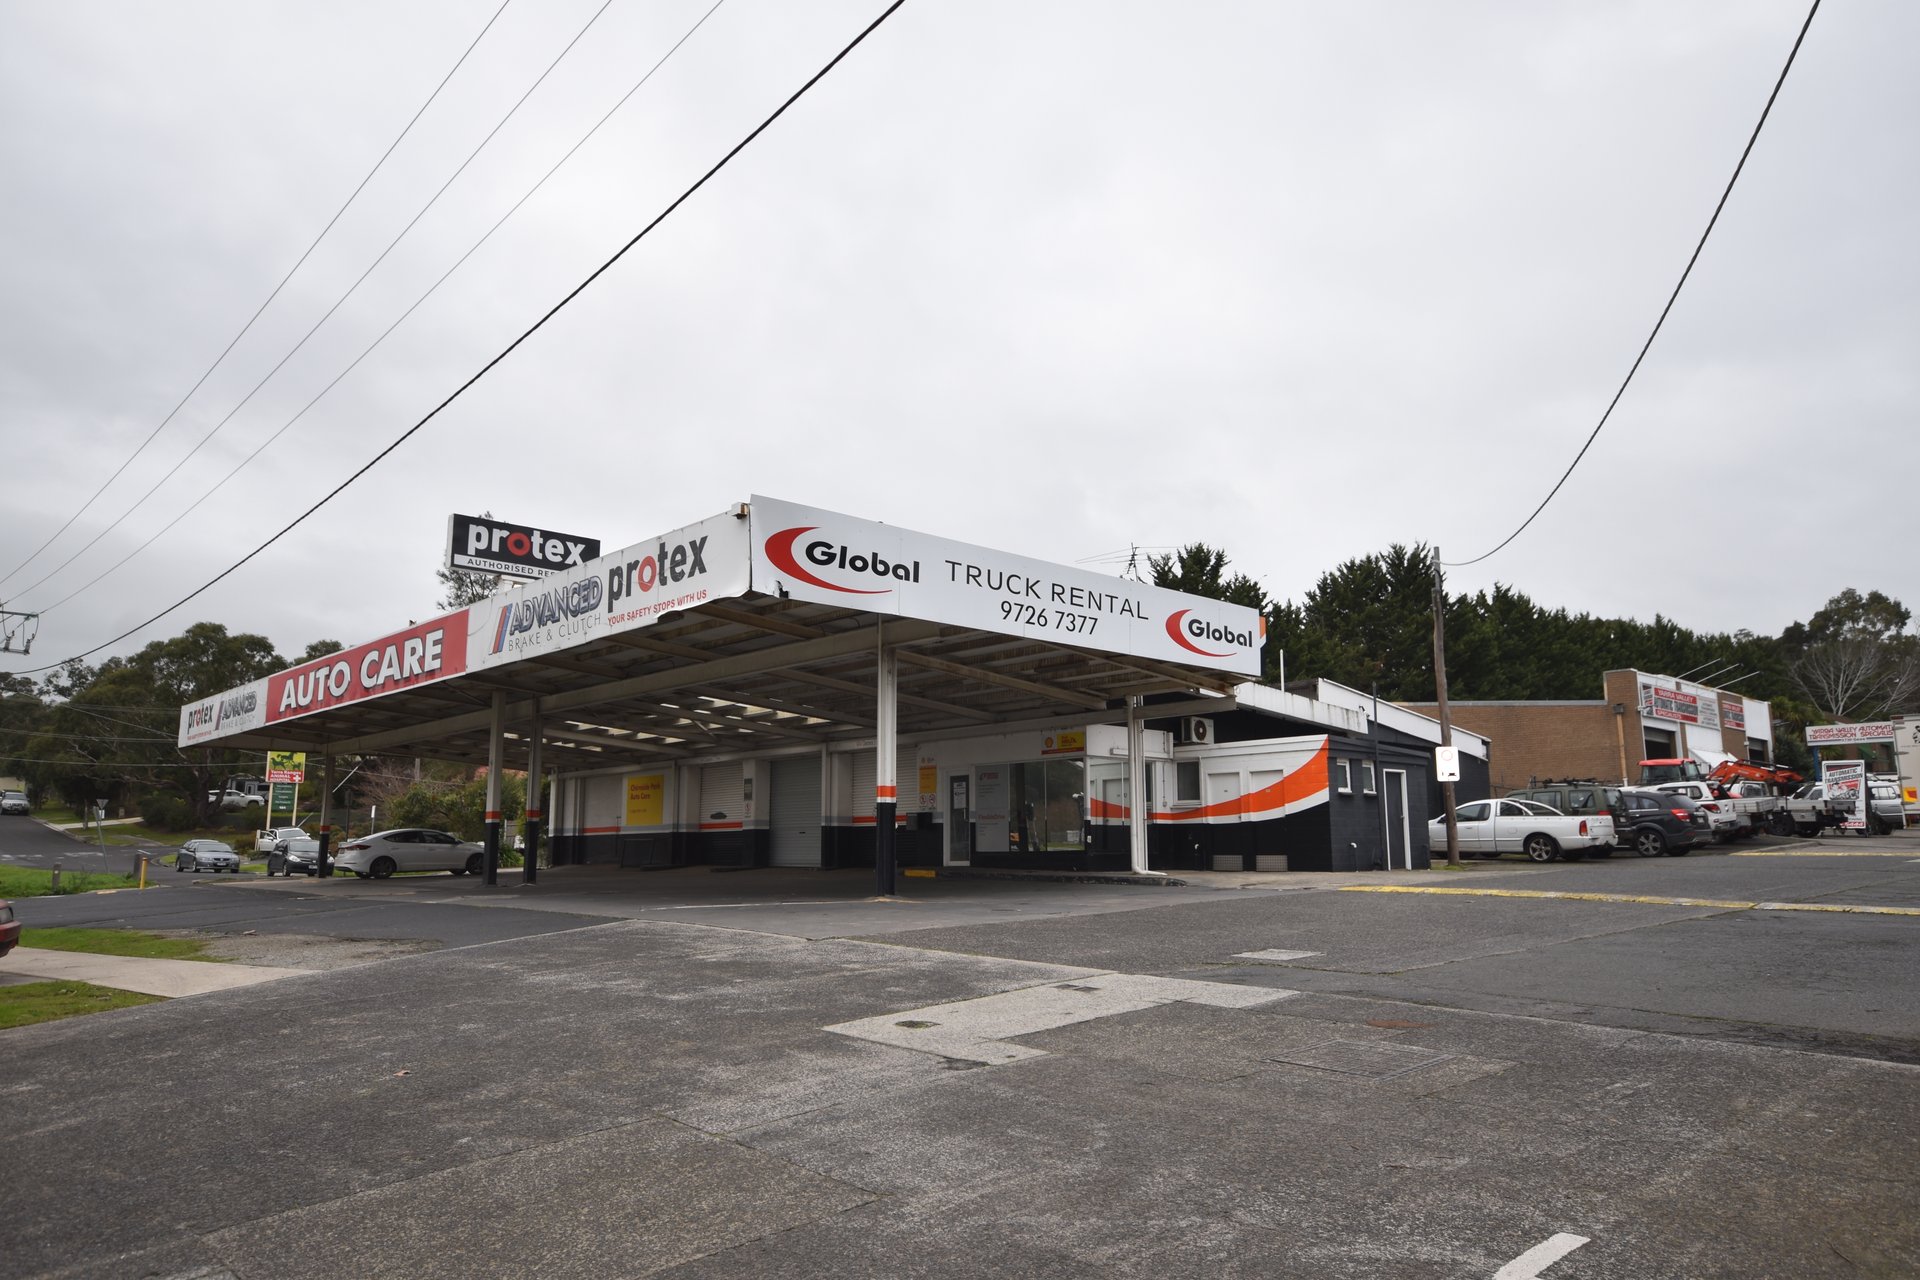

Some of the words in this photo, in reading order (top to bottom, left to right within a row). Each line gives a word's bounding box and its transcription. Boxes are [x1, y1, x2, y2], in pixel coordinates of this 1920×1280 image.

[468, 523, 586, 566] protex
[805, 541, 920, 583] Global
[467, 558, 535, 575] AUTHORISED
[538, 569, 556, 577] RE
[608, 535, 708, 613] protex
[509, 575, 604, 636] ADVANCED
[608, 614, 625, 627] YOUR
[627, 606, 652, 620] SAFETY
[653, 599, 676, 614] STOPS
[677, 593, 695, 606] WITH
[697, 589, 707, 600] US
[945, 560, 1041, 599] TRUCK
[1051, 583, 1149, 620] RENTAL
[508, 631, 541, 652] BRAKE
[546, 629, 553, 641] &
[558, 613, 601, 638] CLUTCH
[1001, 601, 1048, 627] 9726
[1055, 611, 1099, 635] 7377
[1188, 618, 1252, 648] Global
[279, 660, 351, 713] AUTO
[360, 628, 444, 689] CARE
[187, 703, 214, 735] protex
[1809, 732, 1857, 740] TRANSMISSION
[1825, 773, 1863, 784] TRANSMISSION
[1829, 767, 1858, 777] AUTOMATIC
